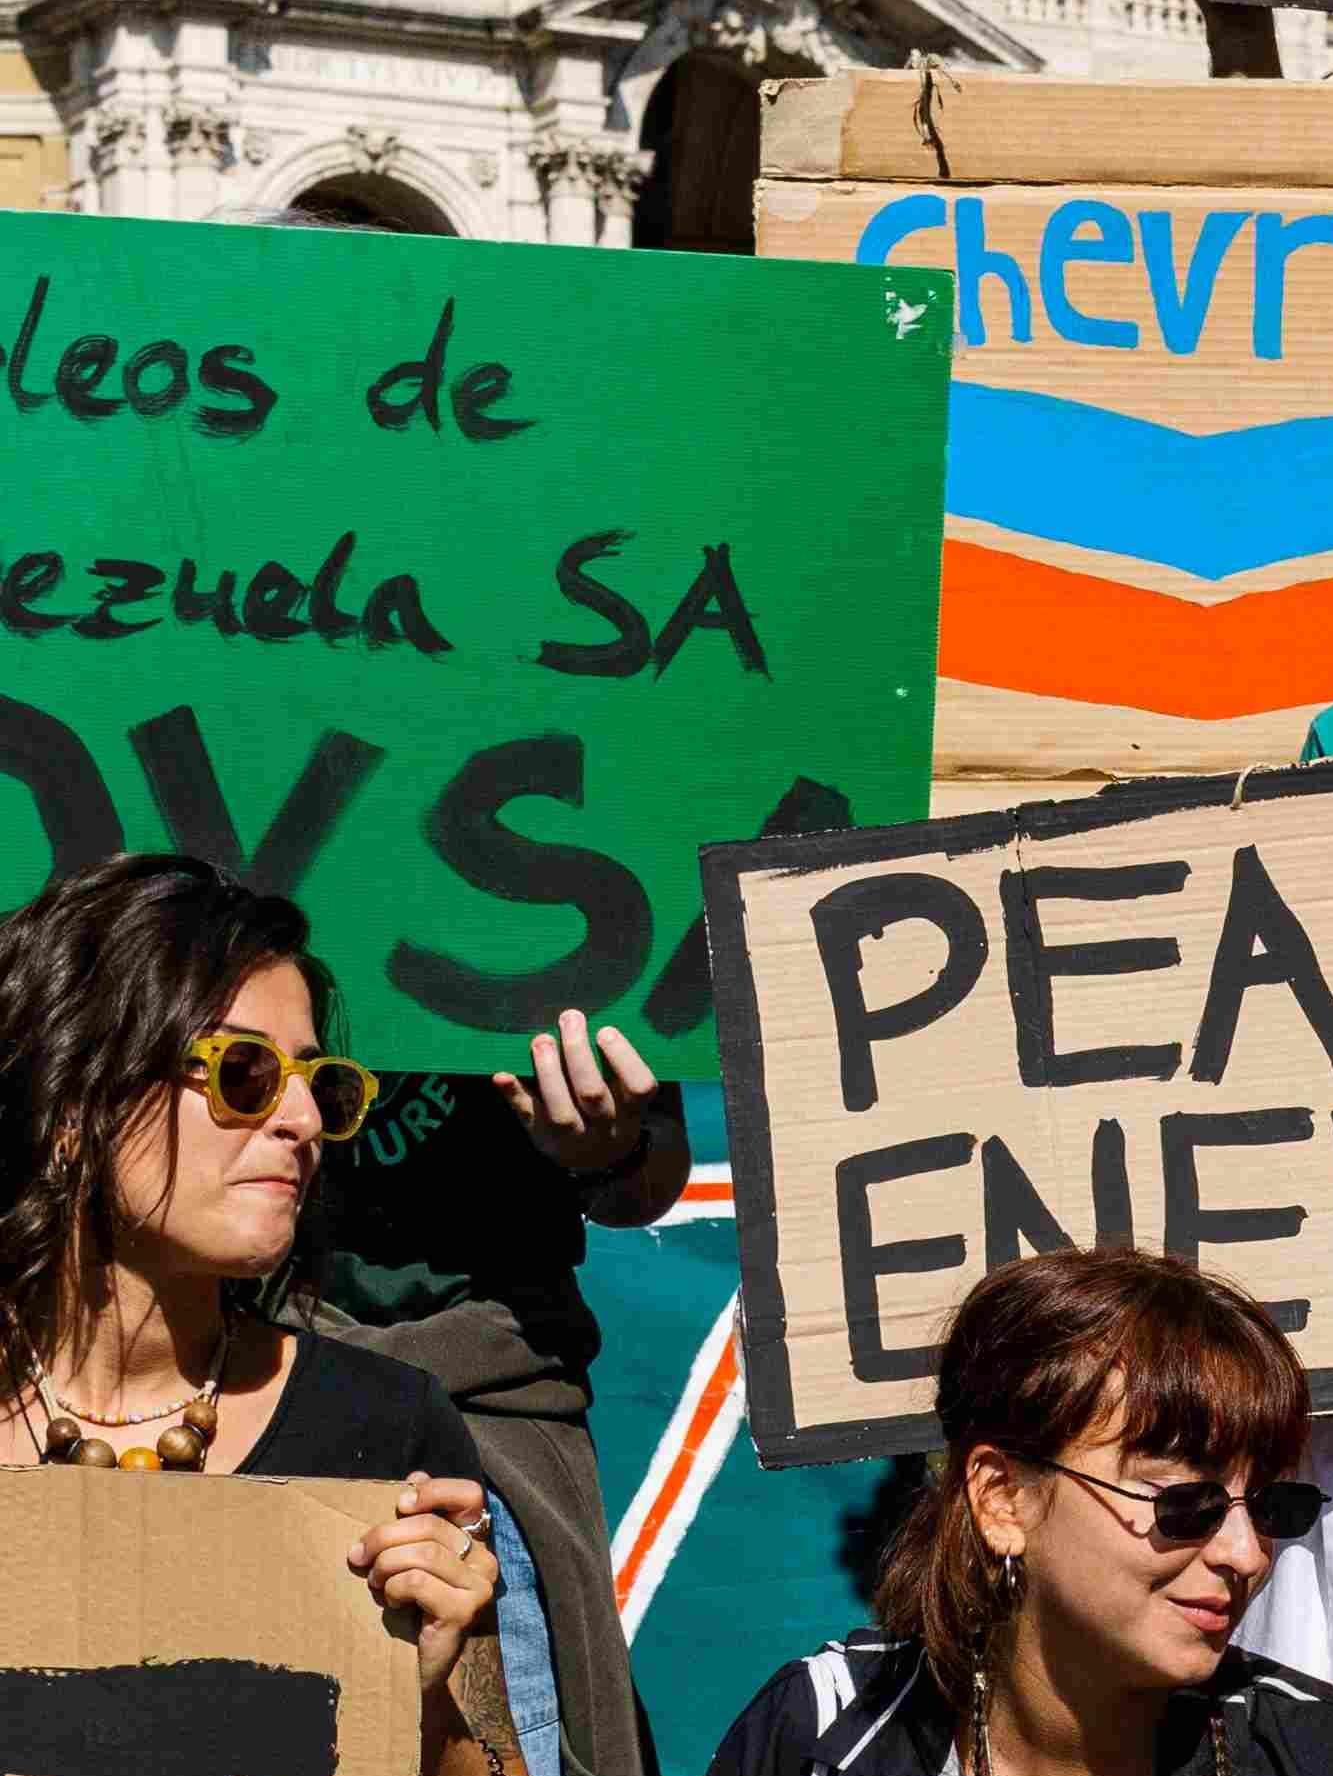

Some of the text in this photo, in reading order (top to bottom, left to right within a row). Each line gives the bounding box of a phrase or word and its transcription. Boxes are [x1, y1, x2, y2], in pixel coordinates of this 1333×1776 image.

[0, 275, 538, 443] leos de
[530, 529, 773, 683] SA
